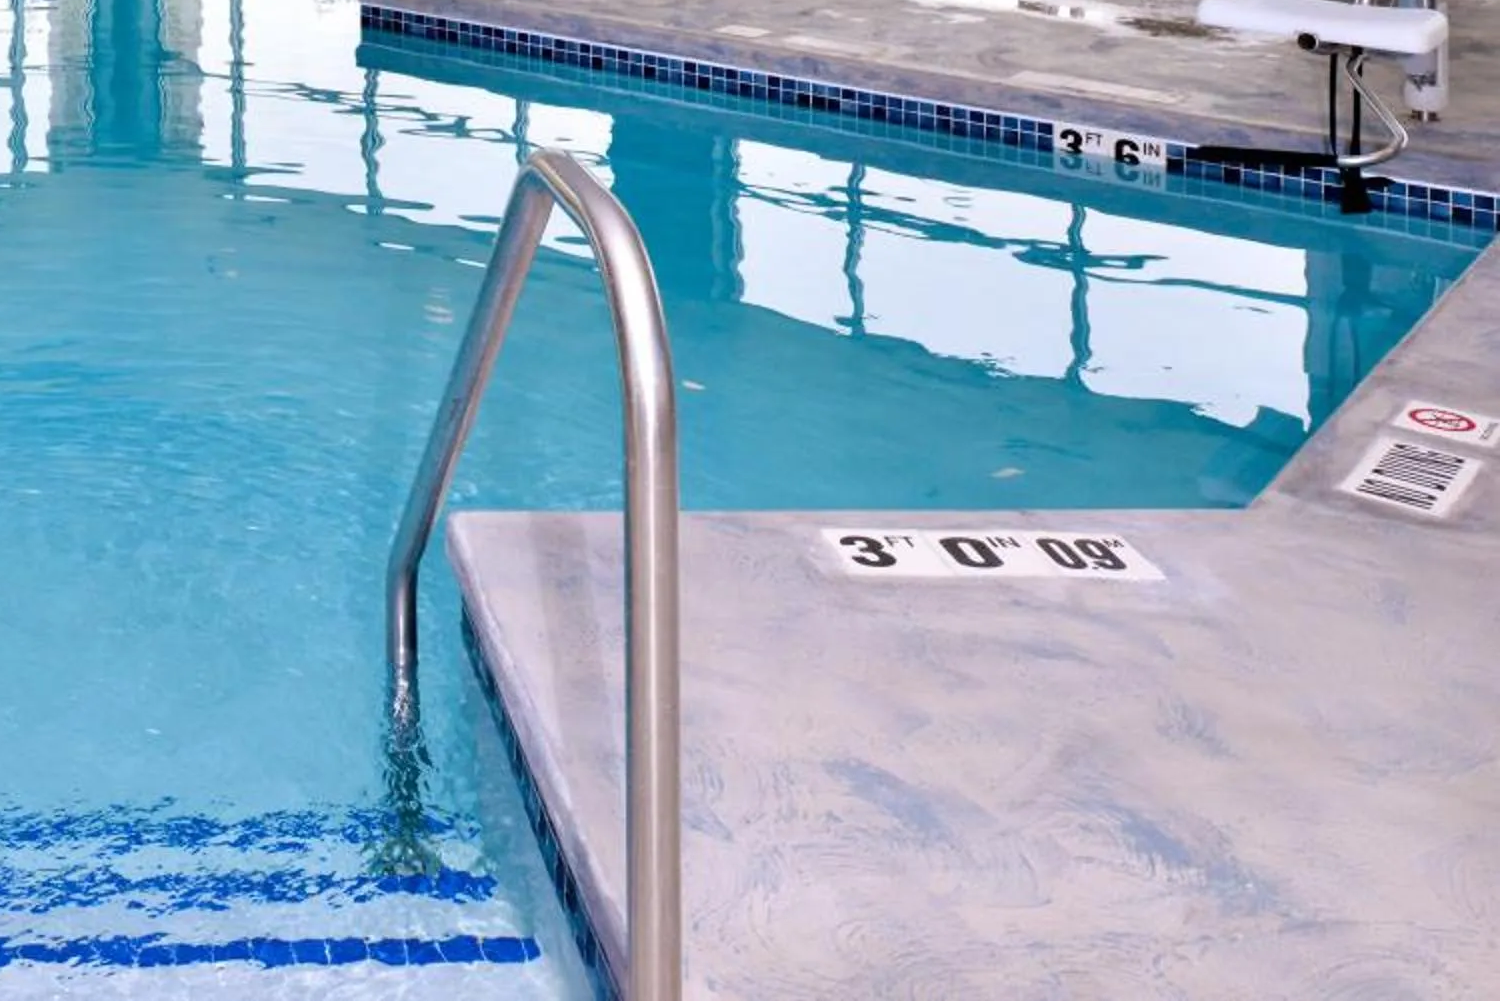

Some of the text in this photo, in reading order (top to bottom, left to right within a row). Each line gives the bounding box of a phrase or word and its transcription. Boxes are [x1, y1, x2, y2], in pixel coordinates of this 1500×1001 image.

[1059, 129, 1160, 166] 3 FT 6 IN
[839, 535, 898, 568] 3
[883, 535, 915, 548] FT
[938, 537, 1005, 569] 0
[985, 536, 1022, 548] IN
